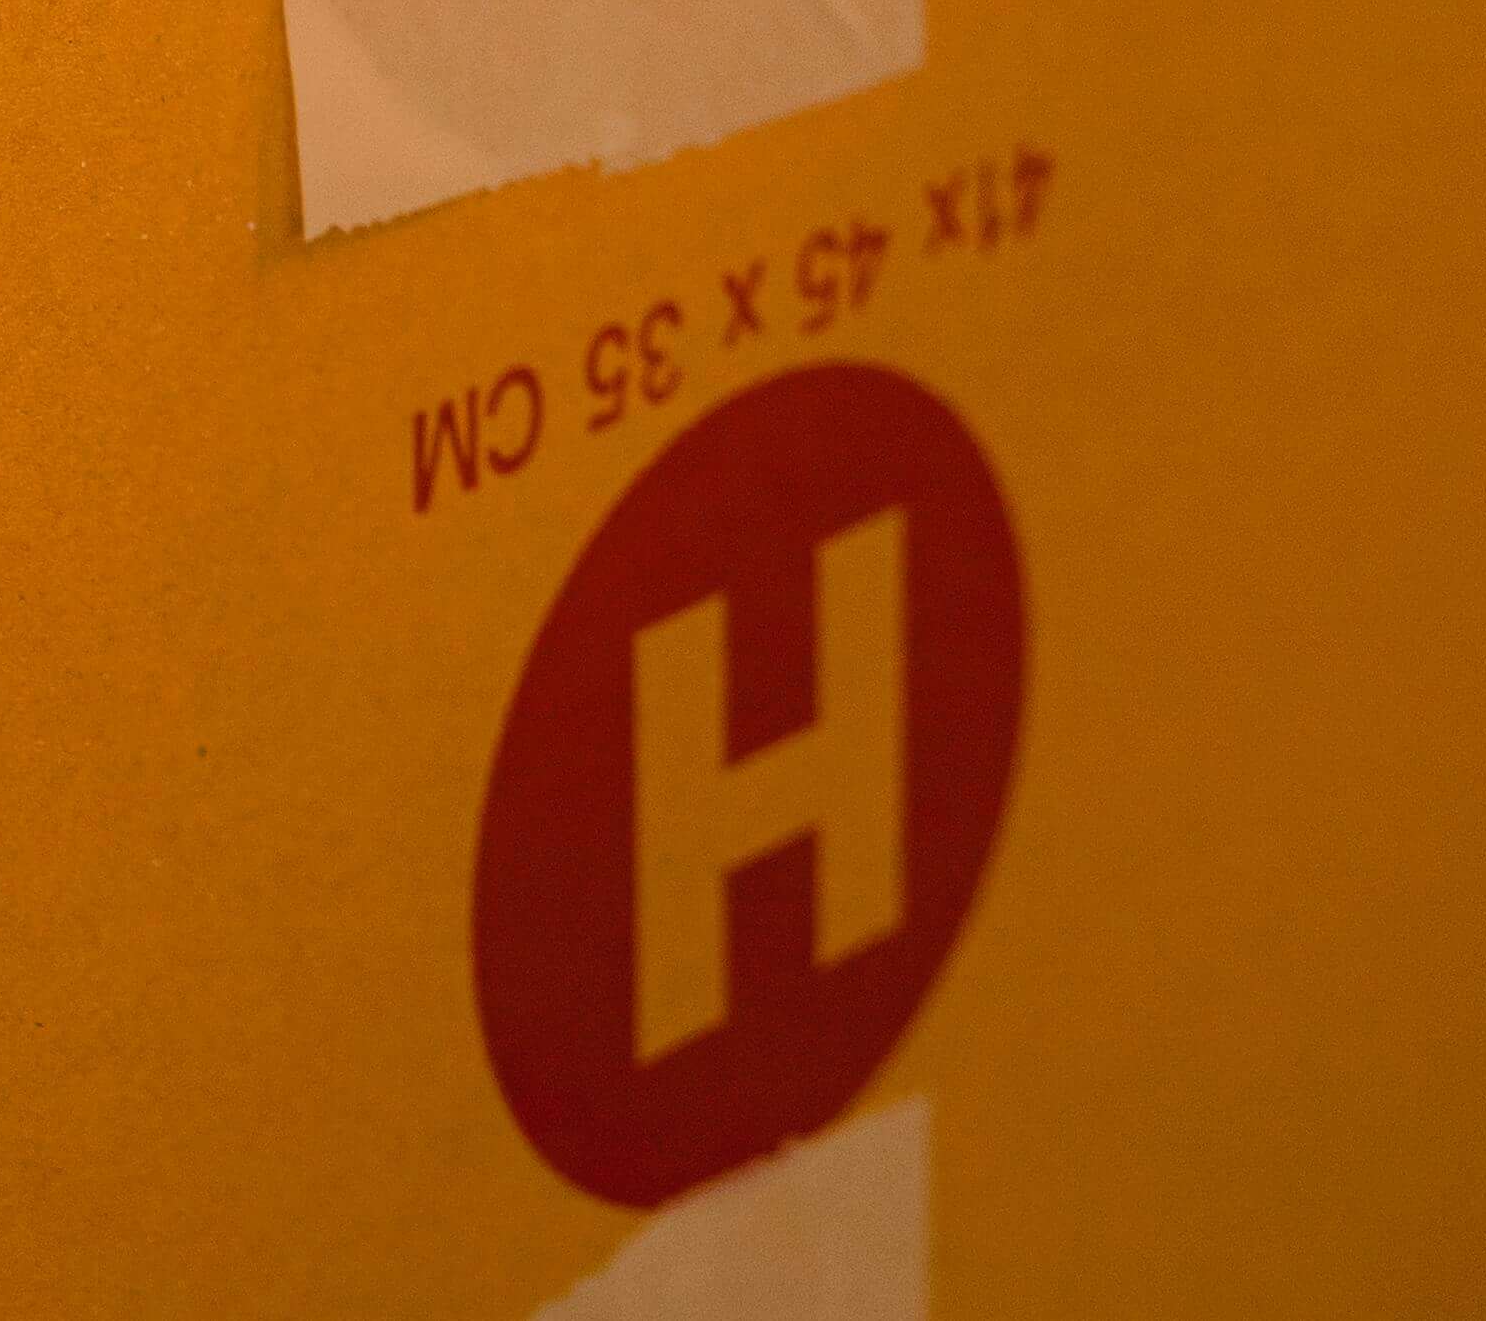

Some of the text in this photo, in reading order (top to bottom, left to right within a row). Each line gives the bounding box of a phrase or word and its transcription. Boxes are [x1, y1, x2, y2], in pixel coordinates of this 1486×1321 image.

[797, 221, 890, 335] 45
[584, 298, 683, 434] 35
[411, 363, 545, 516] CM
[627, 501, 911, 1069] H
